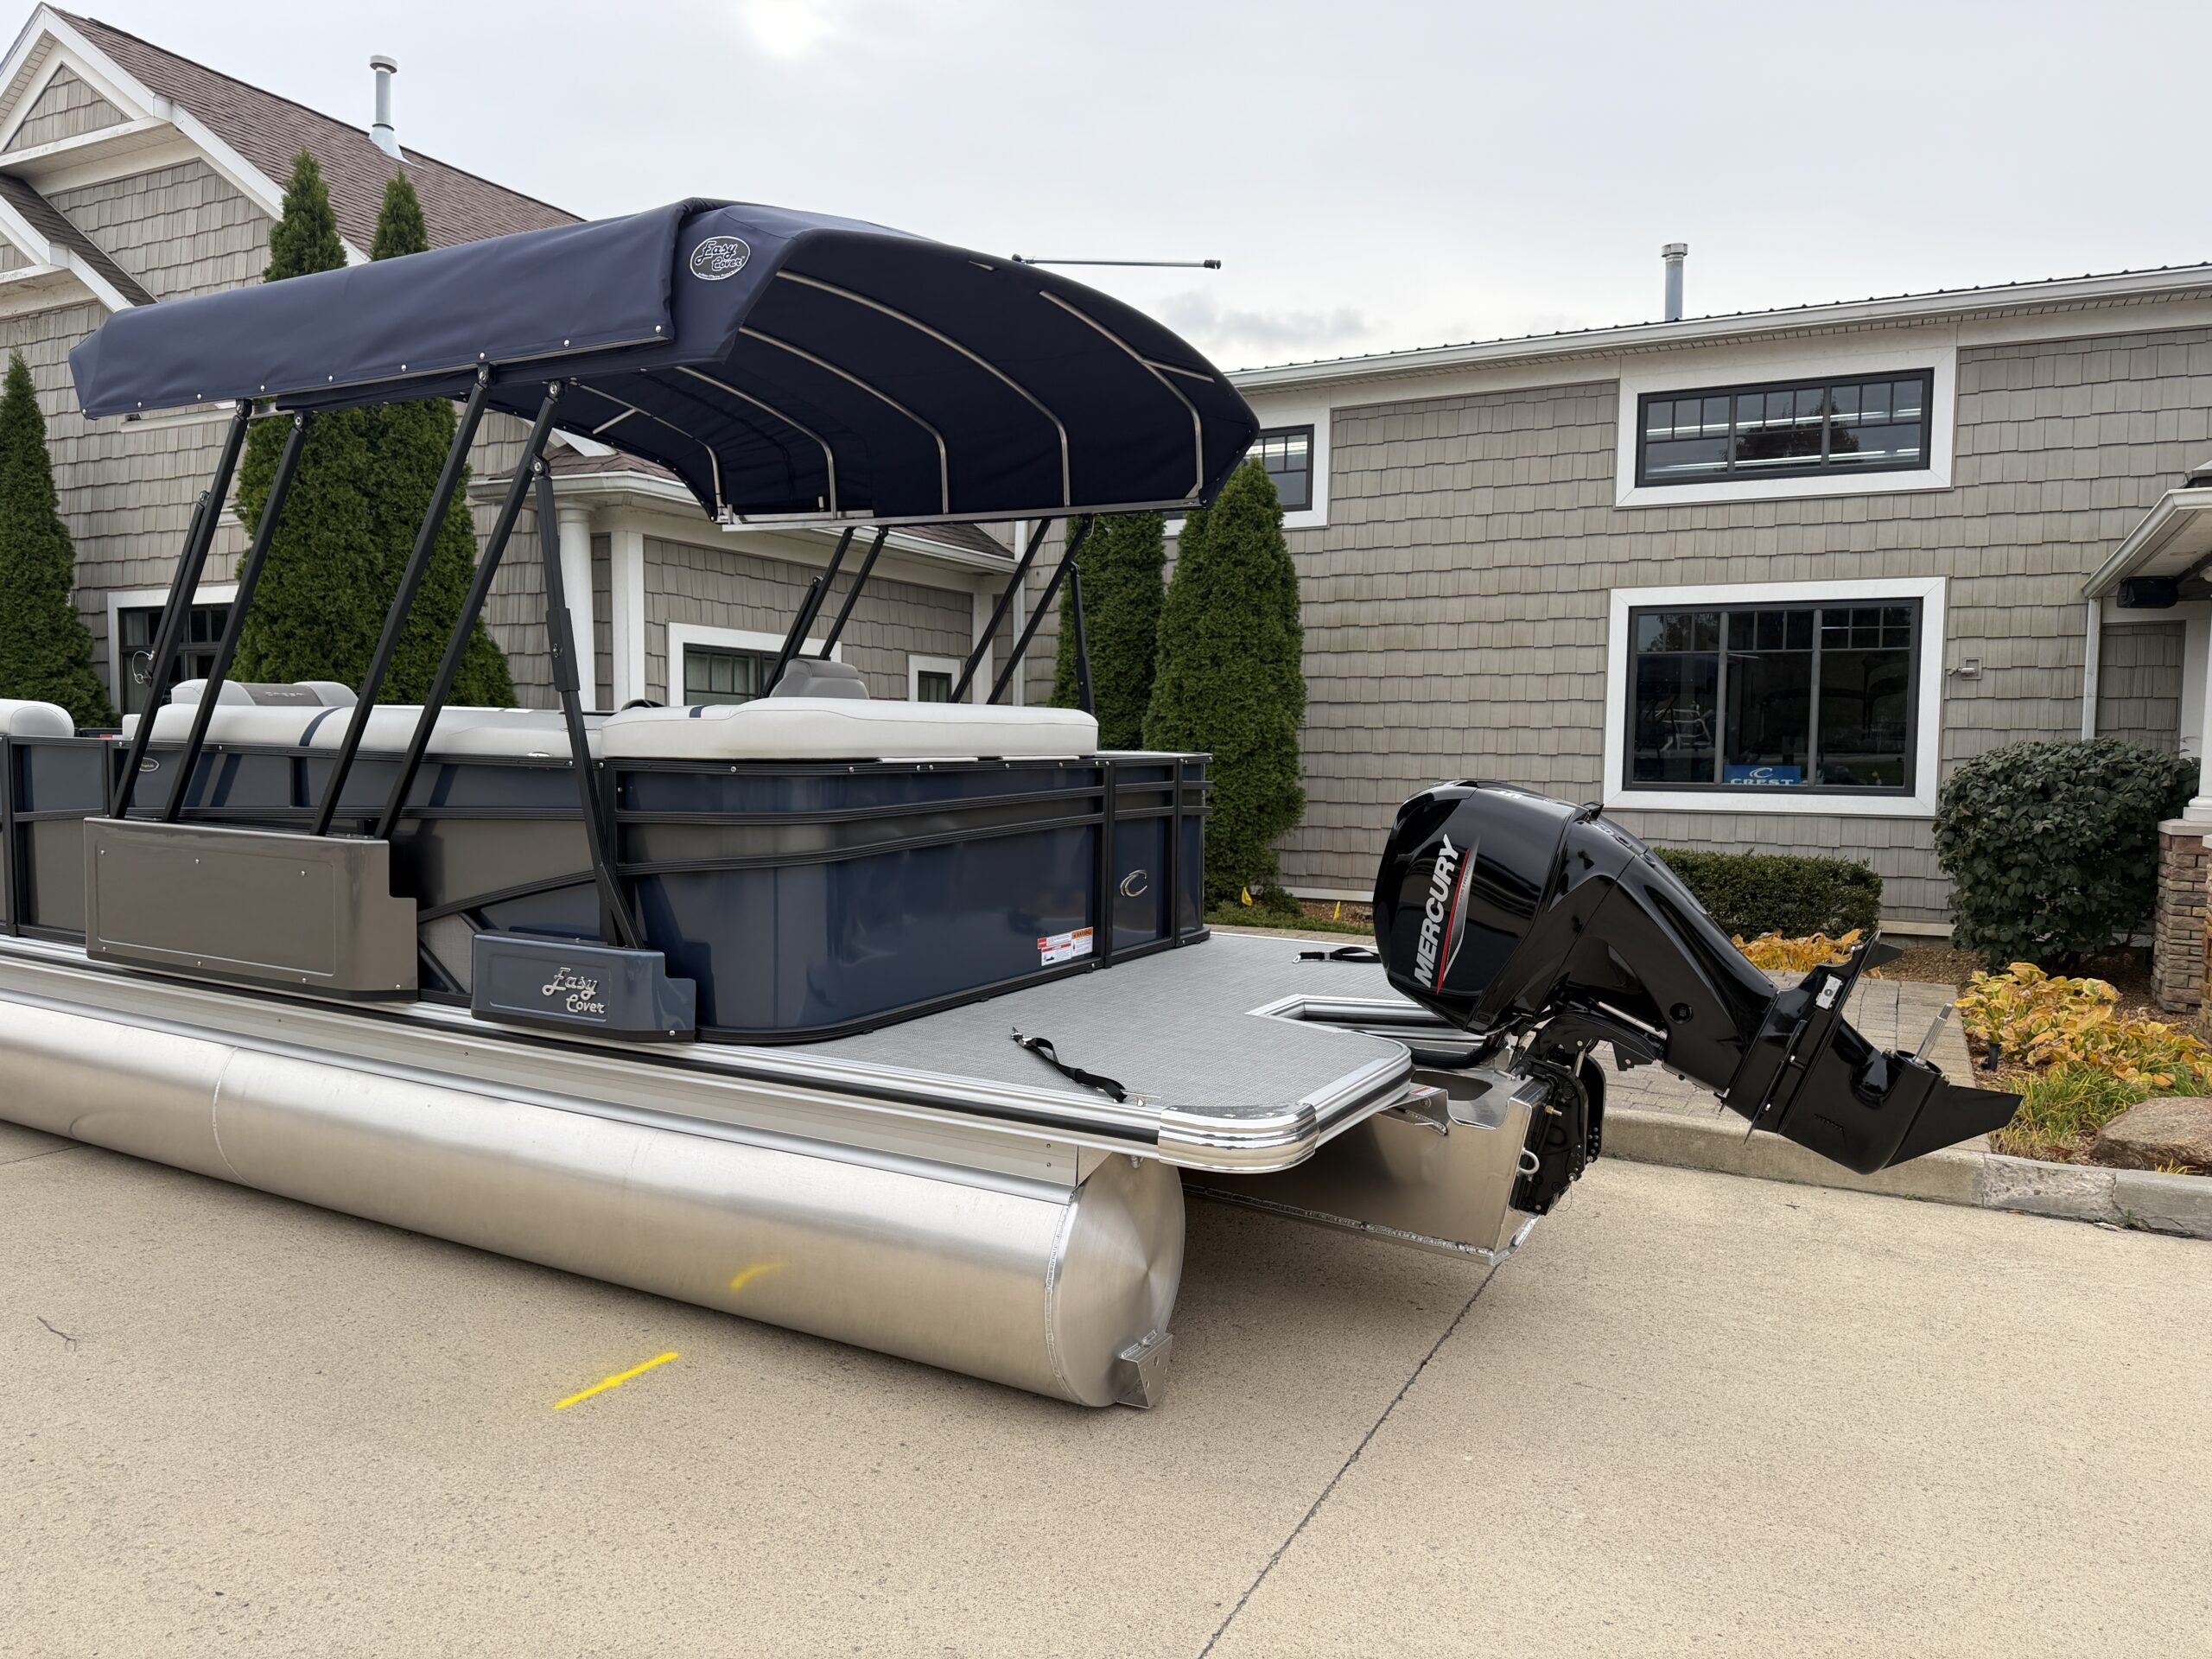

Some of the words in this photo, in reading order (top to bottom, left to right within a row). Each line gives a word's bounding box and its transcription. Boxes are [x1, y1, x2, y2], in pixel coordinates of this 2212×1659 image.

[695, 241, 738, 265] Easy
[711, 256, 743, 271] Cover
[1414, 833, 1459, 988] MERCURY
[542, 967, 598, 1001] Easy
[566, 994, 606, 1014] Cover
